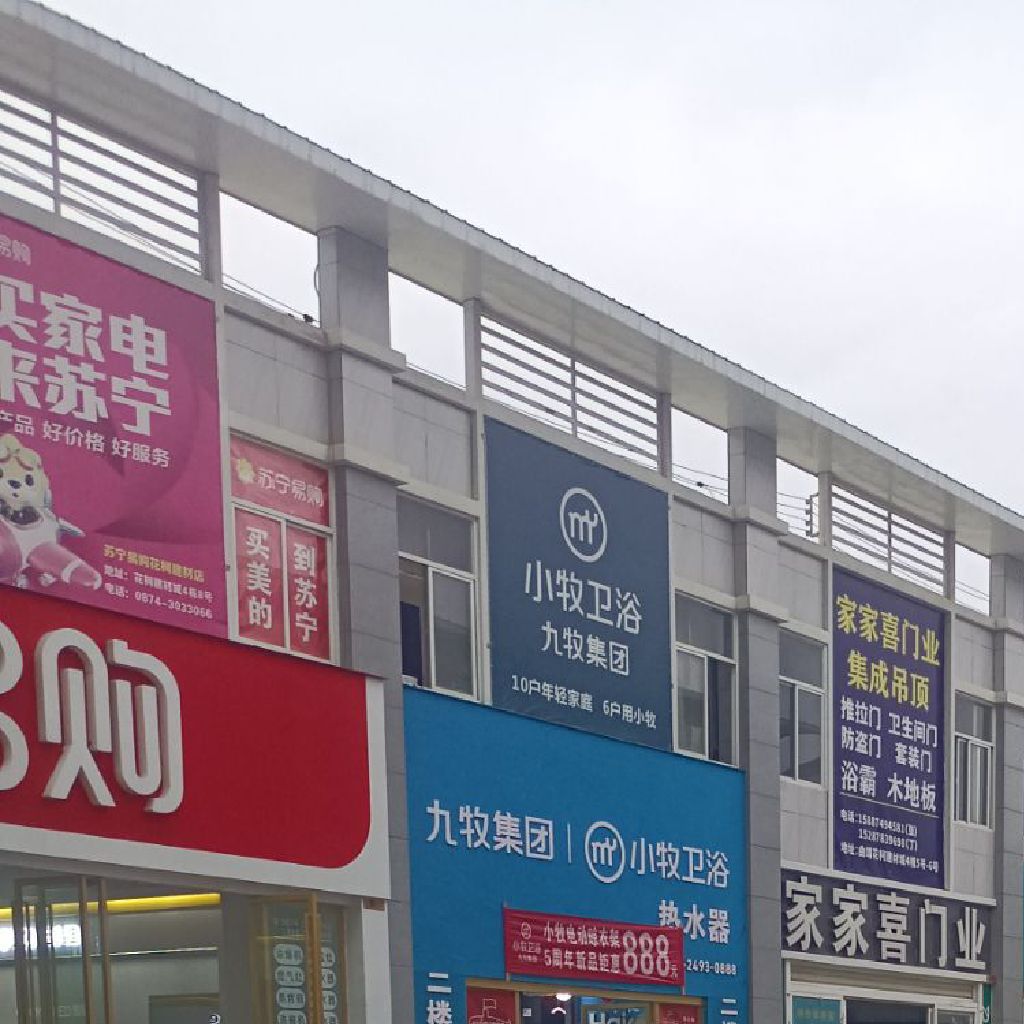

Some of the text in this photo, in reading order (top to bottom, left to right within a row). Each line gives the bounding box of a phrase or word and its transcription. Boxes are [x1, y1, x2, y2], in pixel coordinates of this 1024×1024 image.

[43, 420, 105, 453] 好价格
[112, 436, 169, 467] 好服务
[257, 467, 324, 508] 苏宁易购
[246, 524, 272, 631] 买美的
[293, 543, 318, 643] 到苏宁
[525, 560, 642, 634] 小牧卫浴
[541, 621, 630, 676] 九牧集团
[836, 593, 940, 667] 家家喜门业
[847, 649, 930, 711] 集成吊顶
[0, 621, 185, 815] 购
[602, 699, 657, 729] 6户用小牧
[841, 694, 938, 748] 推拉门 卫生间门
[841, 725, 932, 773] 防盗门 套装门
[841, 760, 936, 813] 浴霸 木地板
[426, 800, 730, 888] 九牧集团 小牧卫浴
[658, 899, 730, 944] 热水器
[785, 876, 986, 971] 家家喜门业
